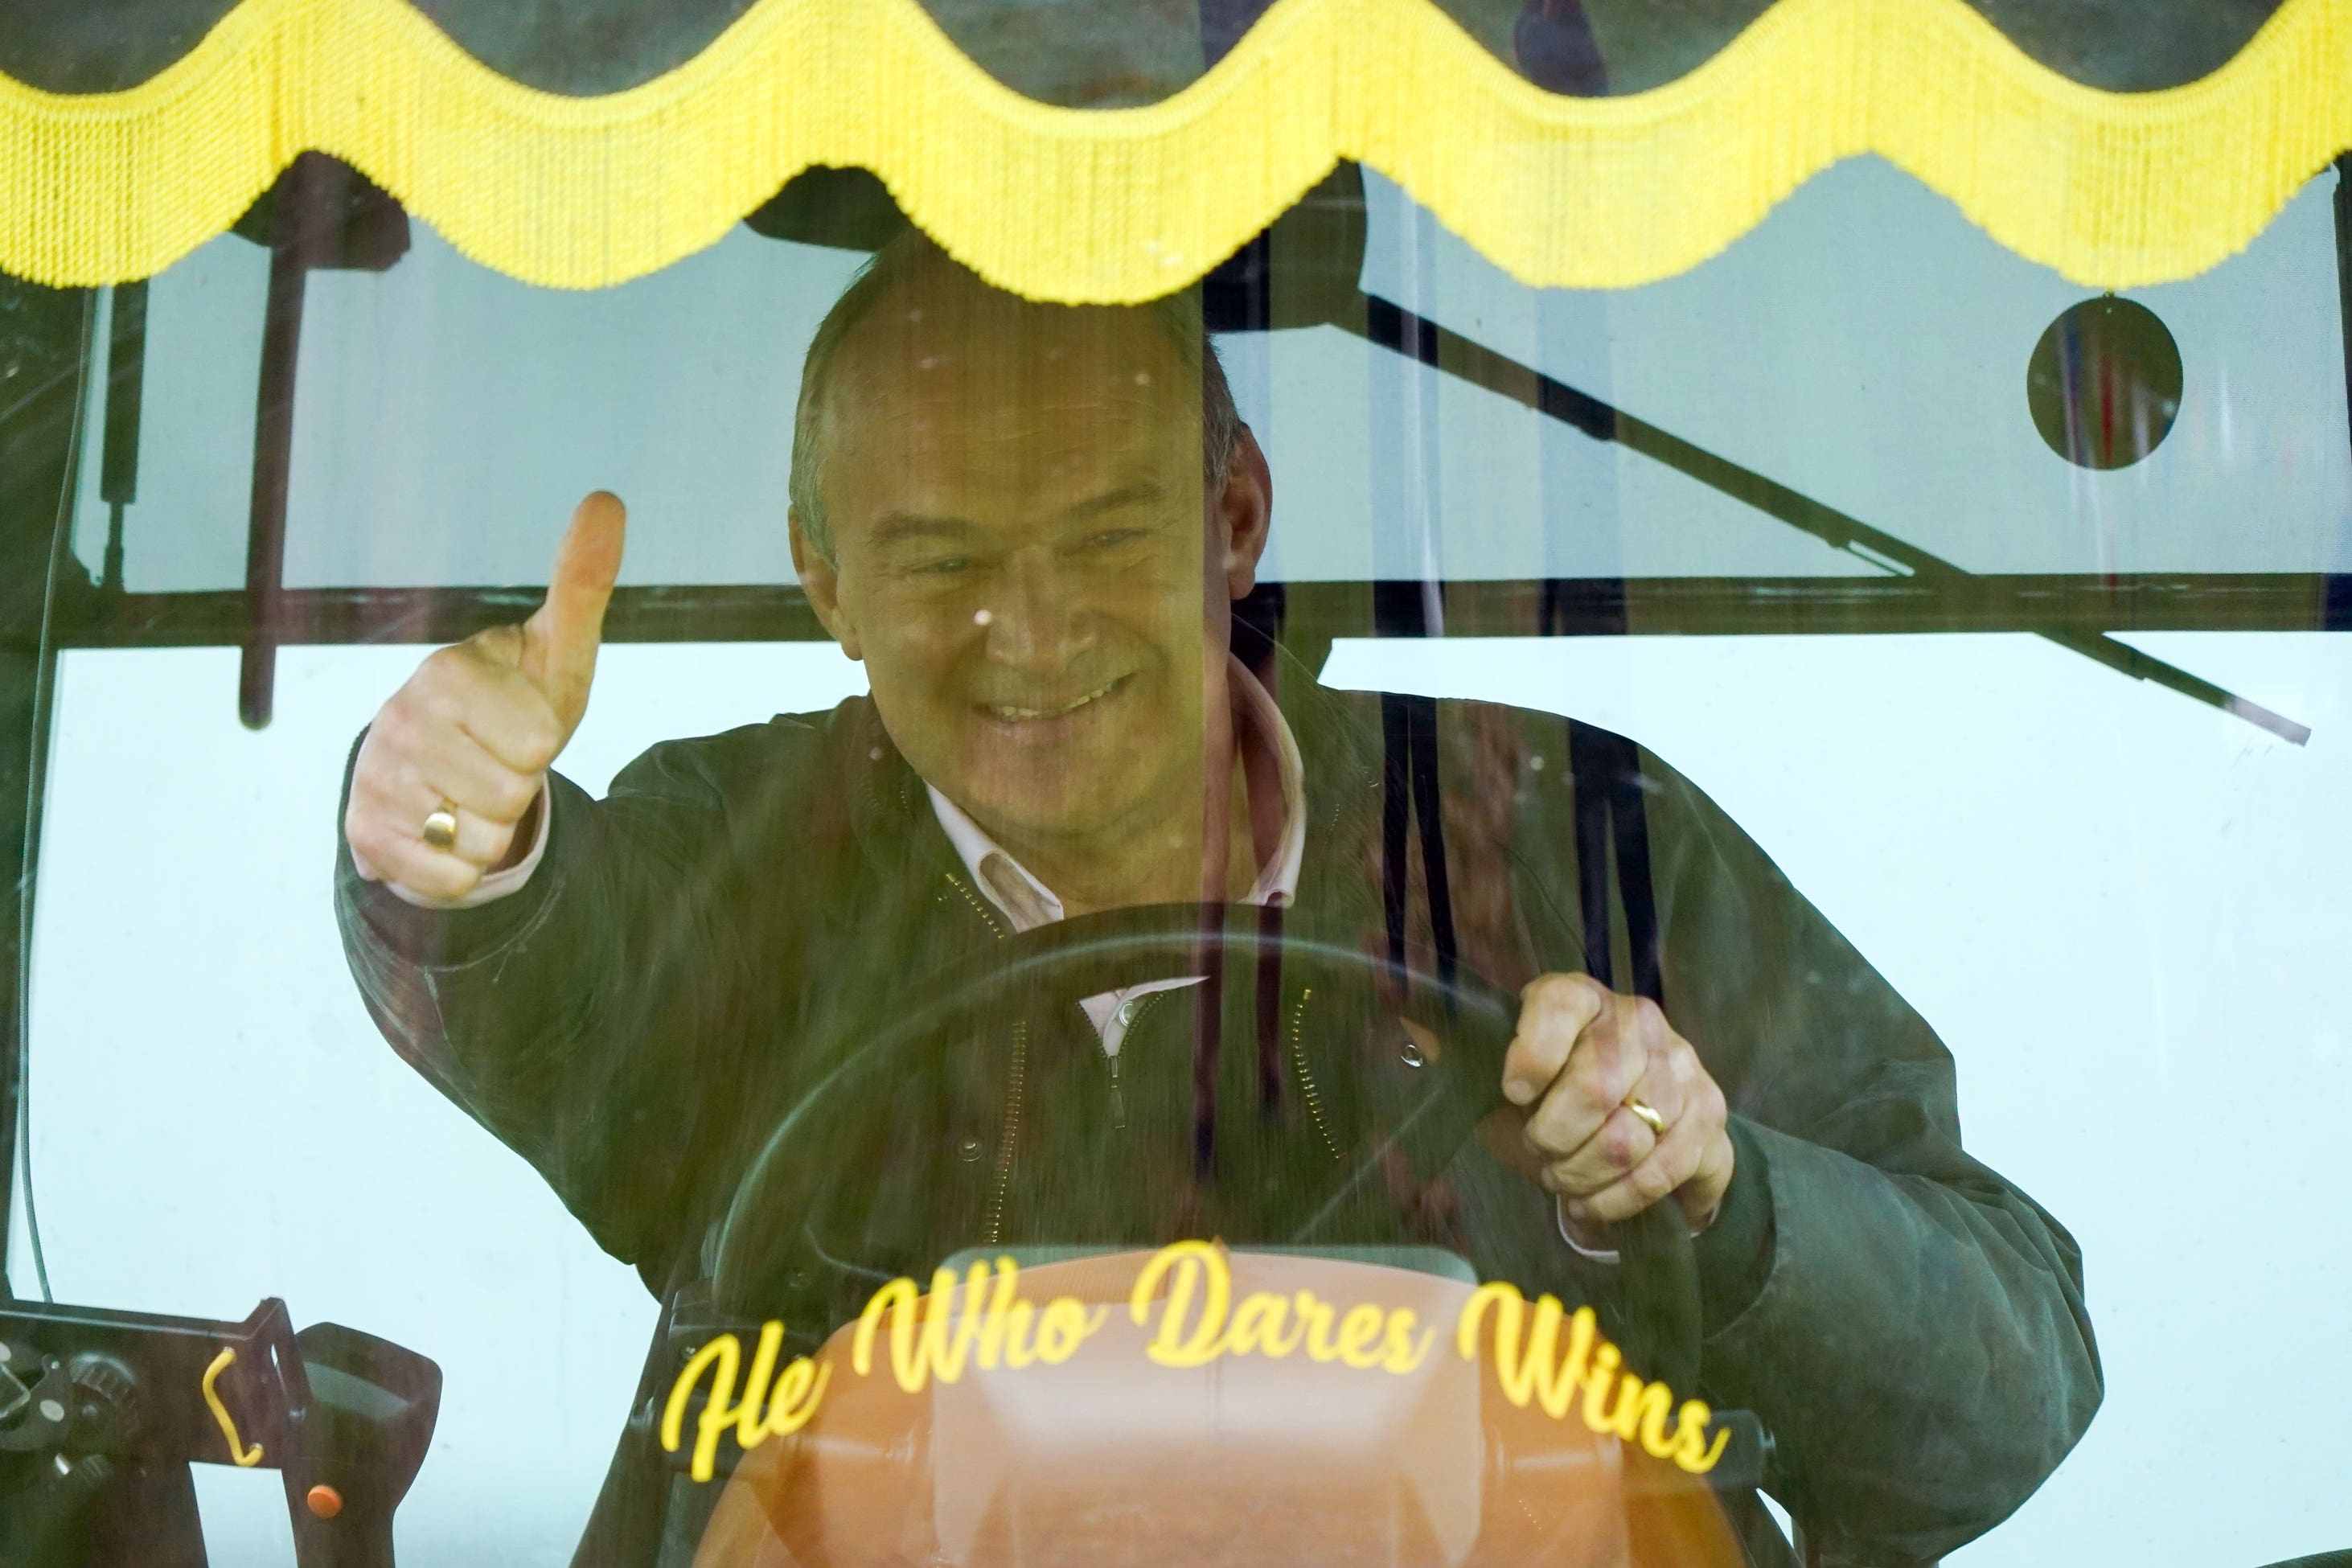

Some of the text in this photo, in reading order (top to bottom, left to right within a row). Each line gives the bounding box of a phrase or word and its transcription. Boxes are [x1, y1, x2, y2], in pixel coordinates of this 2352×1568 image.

[661, 1239, 1731, 1482] He Who Dares Wins
